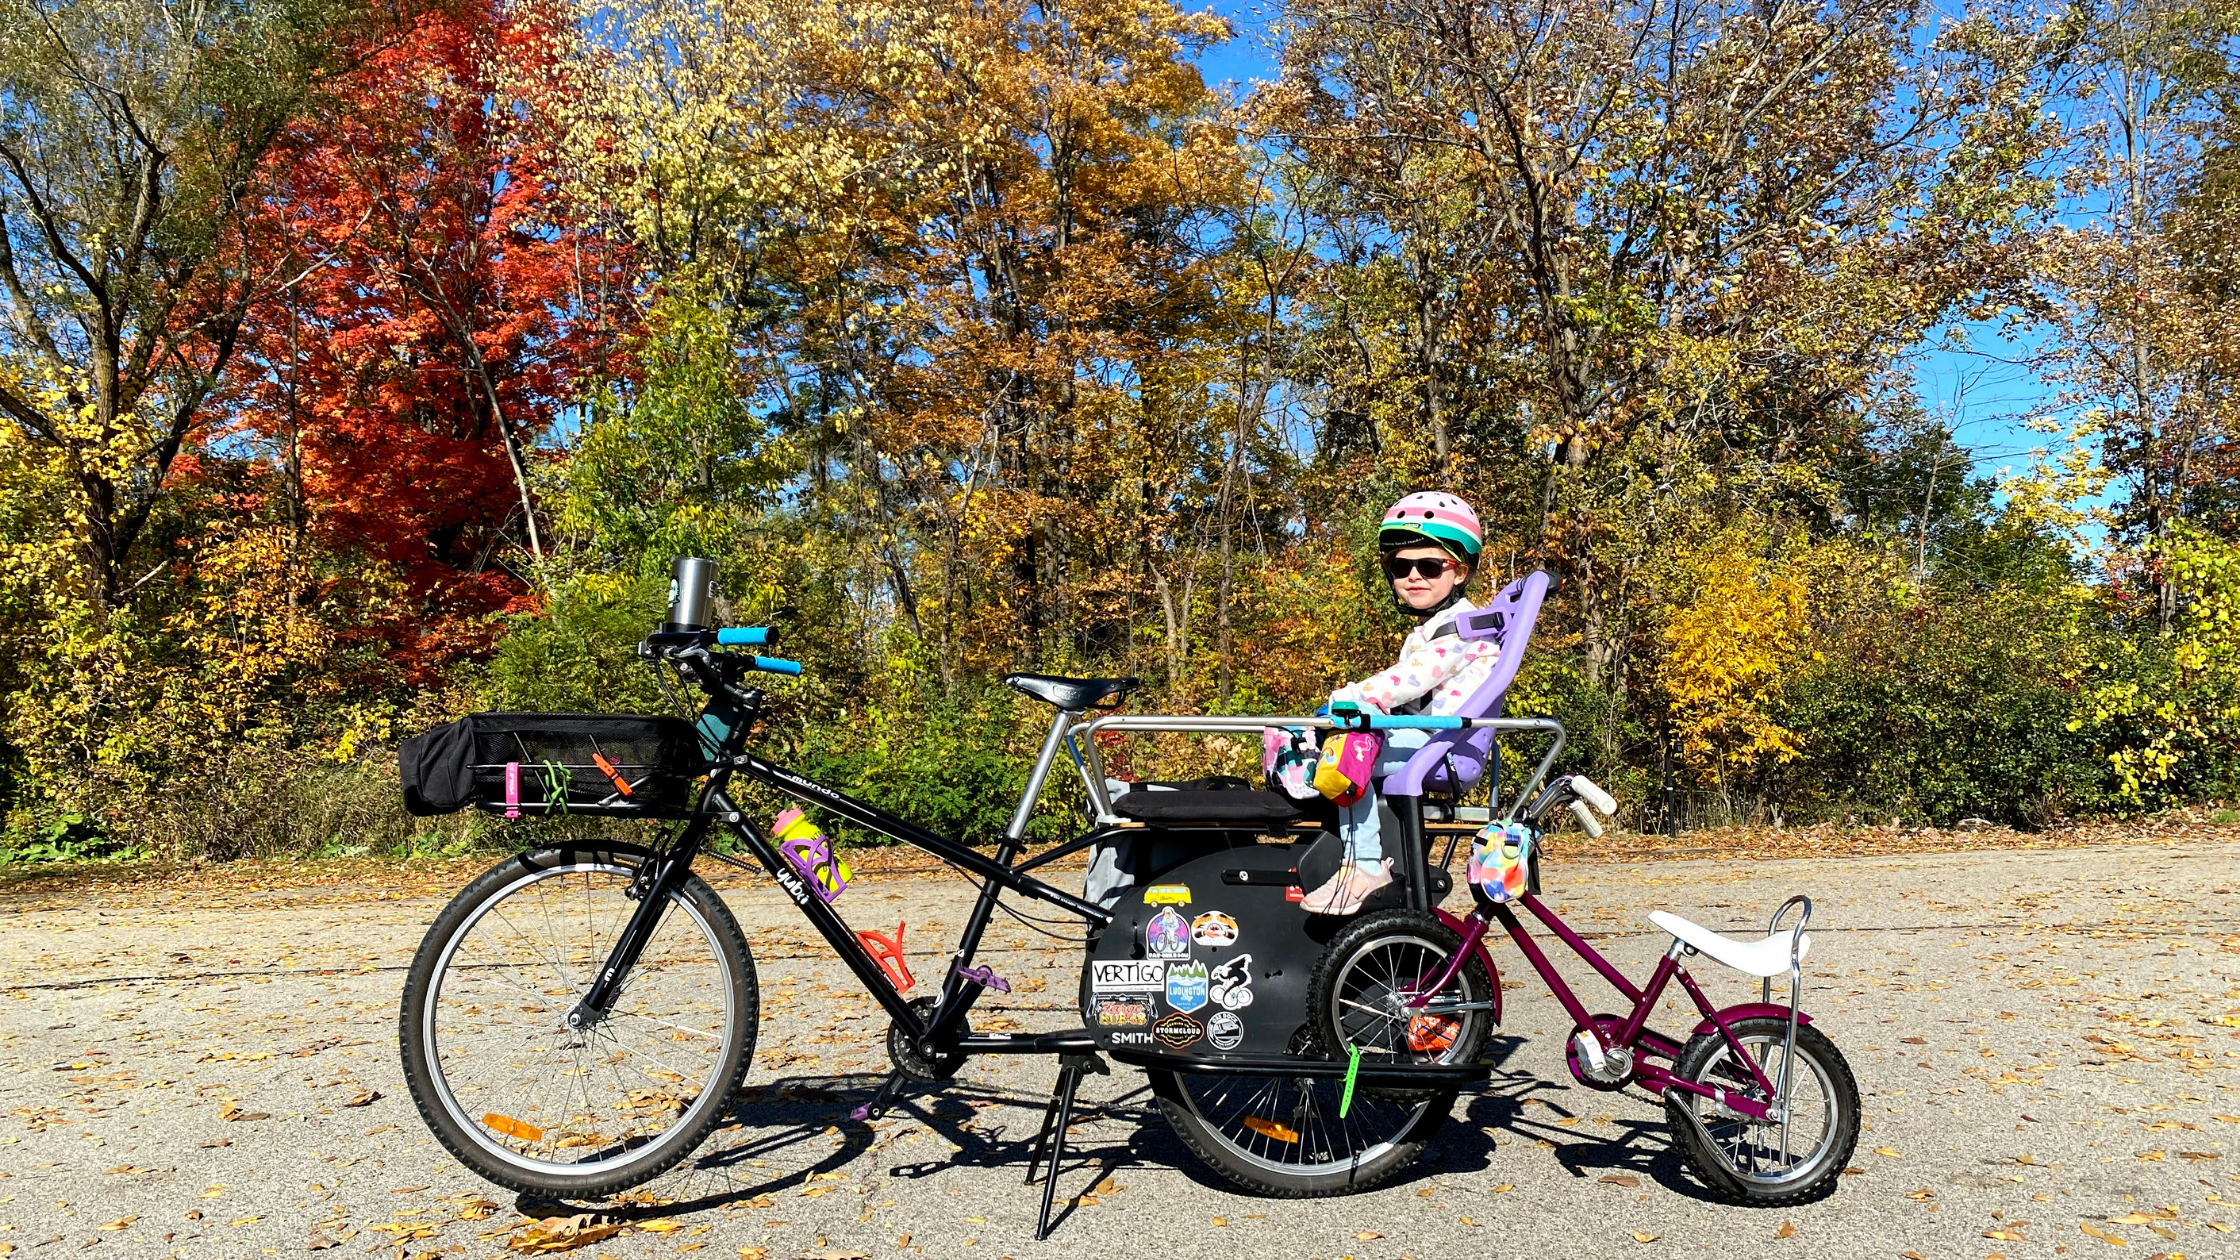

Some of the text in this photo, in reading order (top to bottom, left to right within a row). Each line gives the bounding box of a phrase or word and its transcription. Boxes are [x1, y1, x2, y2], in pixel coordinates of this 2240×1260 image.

[791, 775, 840, 799] mundo
[776, 867, 810, 905] yuba
[1094, 962, 1164, 983] VERTIGO
[1169, 985, 1206, 996] LUDINGTON
[1111, 1032, 1154, 1044] SMITH
[1155, 1027, 1201, 1035] STORMCLOUD
